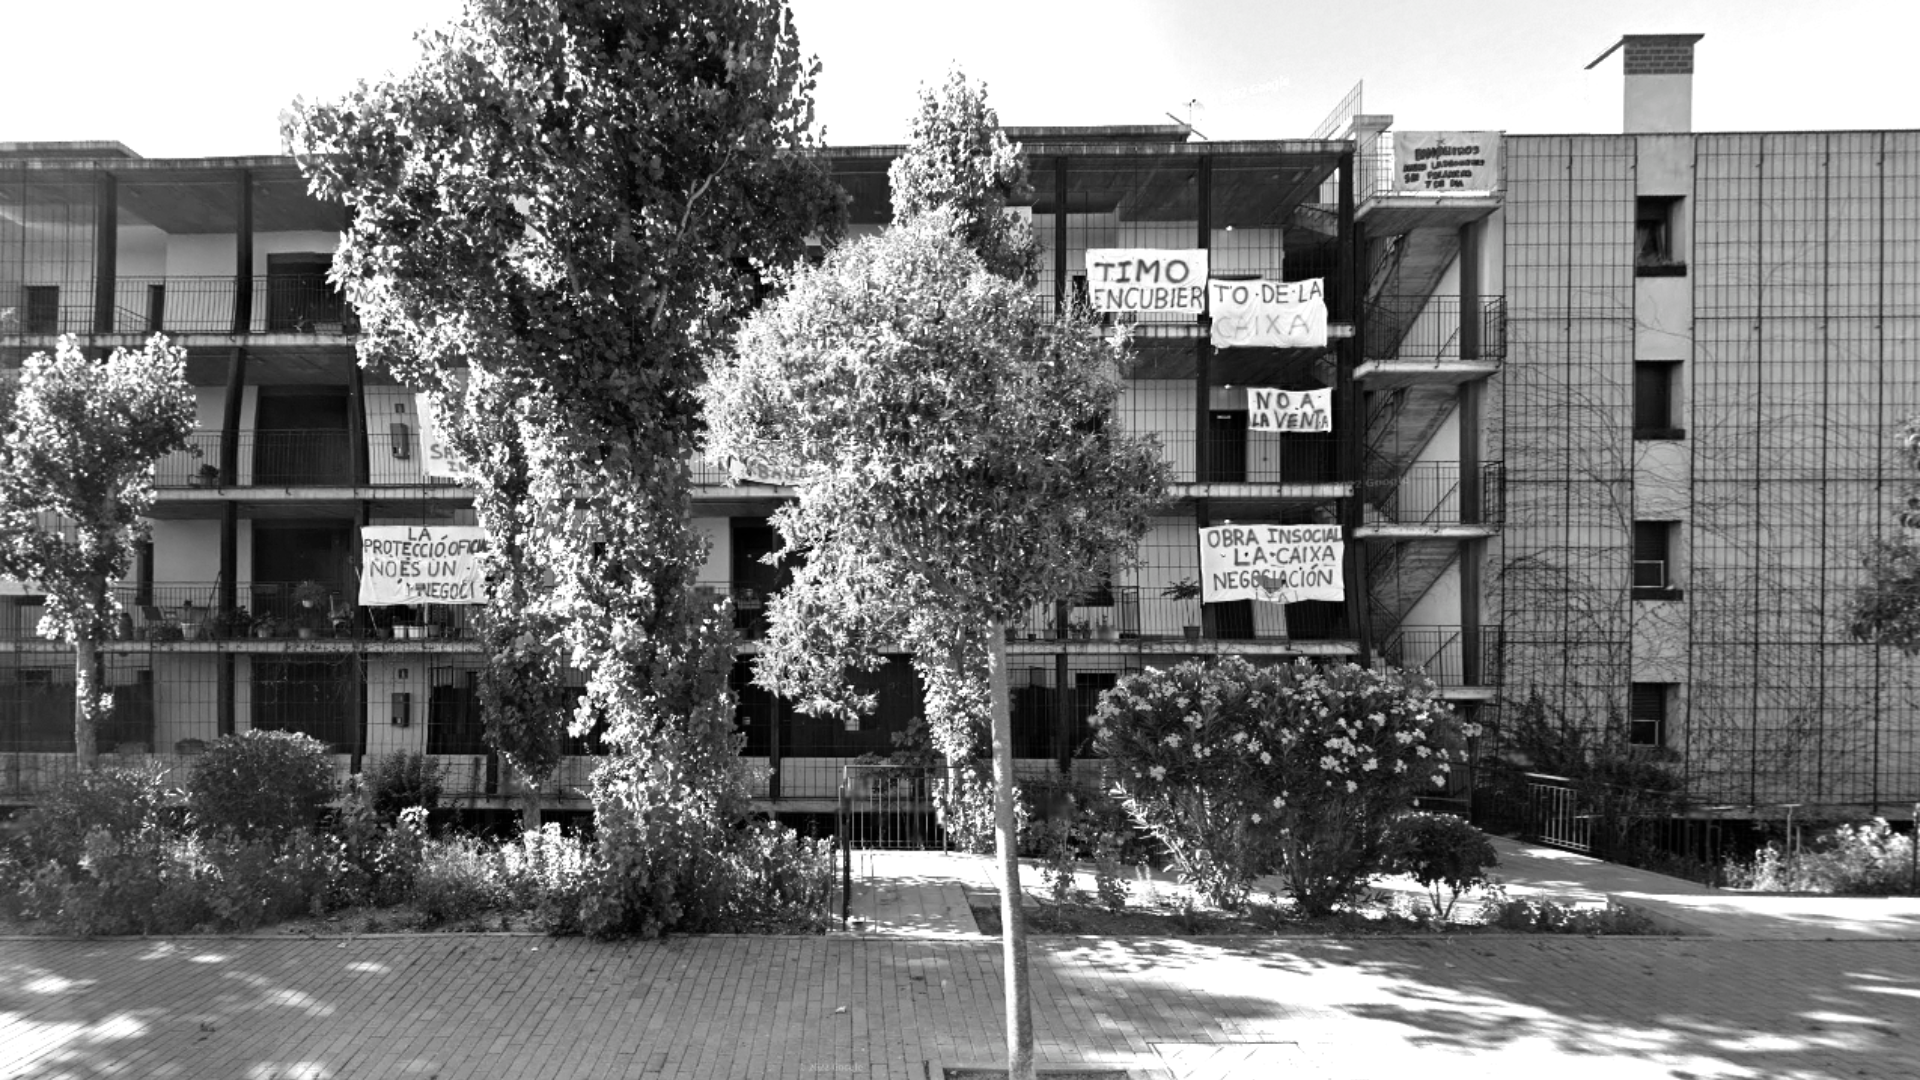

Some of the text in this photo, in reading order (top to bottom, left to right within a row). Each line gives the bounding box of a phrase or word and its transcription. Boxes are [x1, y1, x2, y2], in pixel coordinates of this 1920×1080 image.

[1094, 258, 1190, 284] TIMO
[1094, 286, 1204, 310] ENCUBIER
[1216, 314, 1310, 338] CAIXA
[1256, 391, 1315, 410] NO A
[1252, 409, 1329, 430] LA VENTA
[408, 527, 432, 541] LA
[1207, 528, 1343, 548] OBRA INSOCIAL
[1276, 545, 1336, 564] CAIXA
[428, 560, 456, 577] UN
